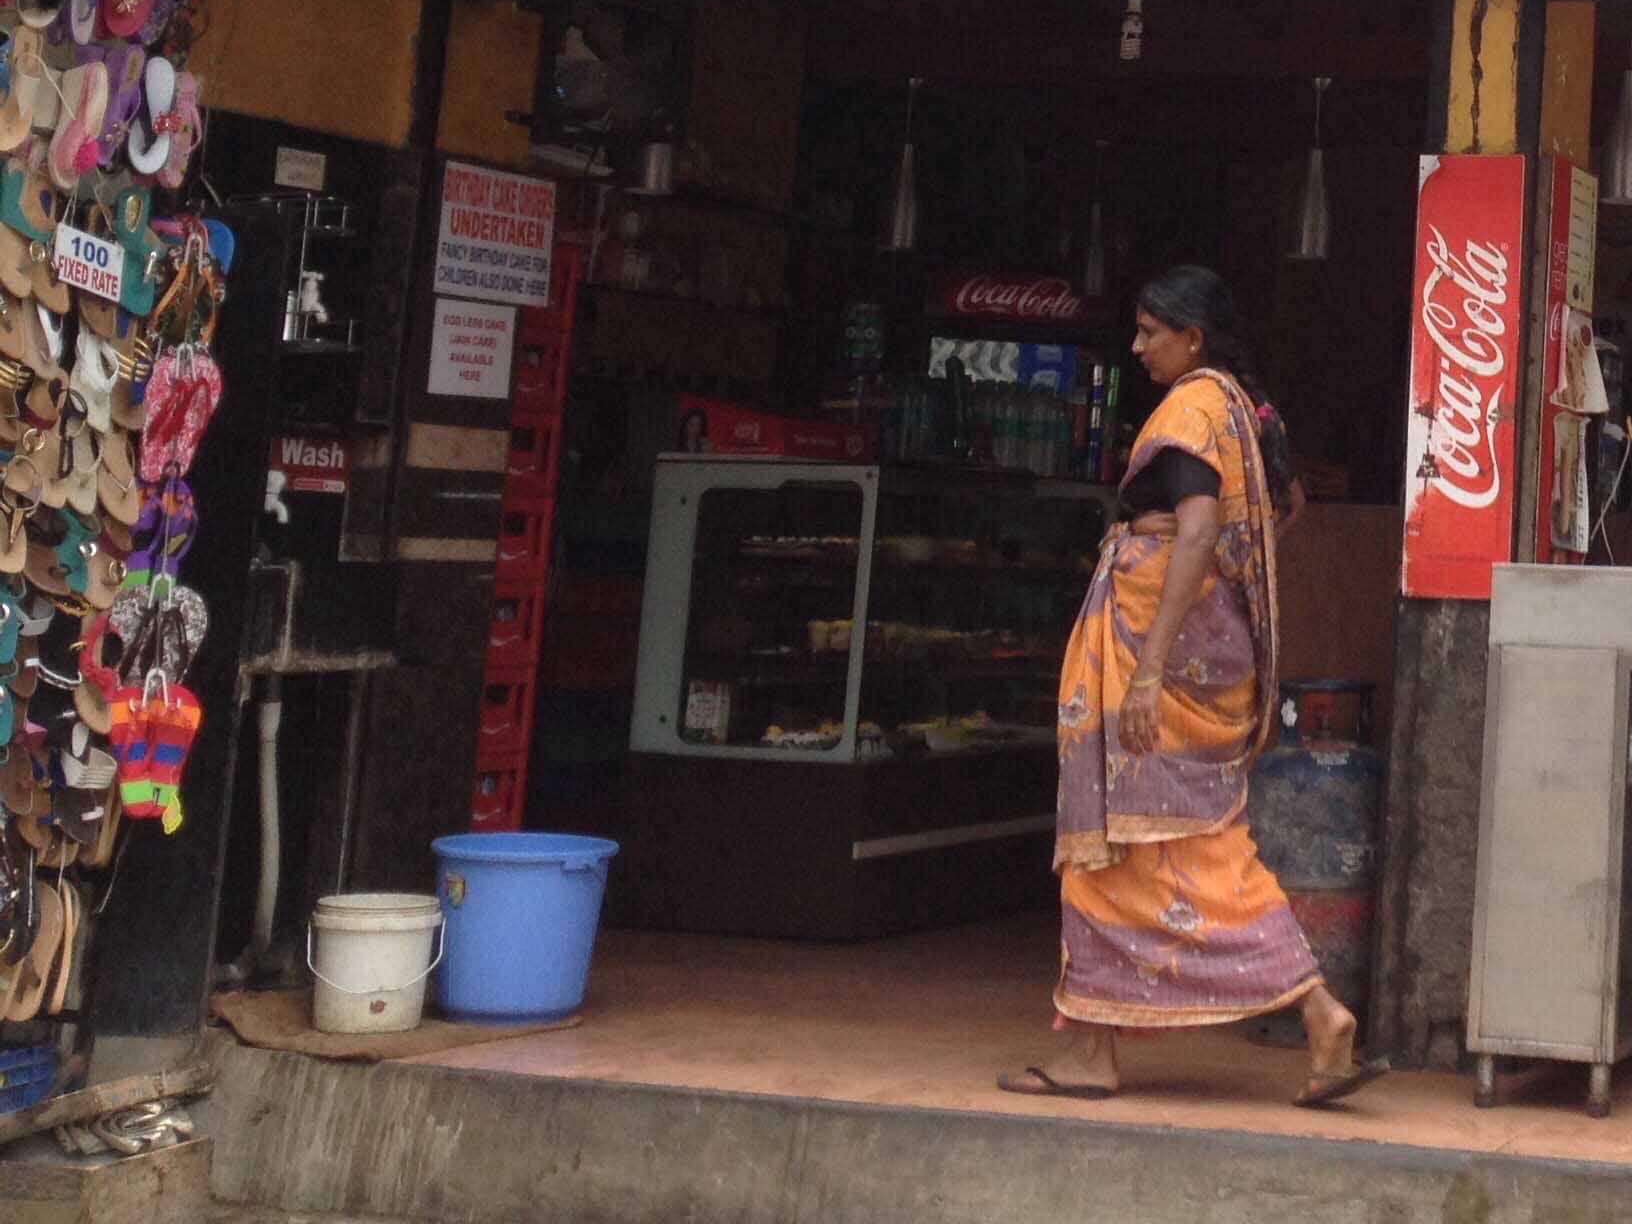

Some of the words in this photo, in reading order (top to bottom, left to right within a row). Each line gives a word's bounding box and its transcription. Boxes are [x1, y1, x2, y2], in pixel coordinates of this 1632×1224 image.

[450, 207, 545, 250] UNDERTAKEN
[71, 236, 108, 268] 100
[58, 255, 88, 285] FIXED
[92, 268, 119, 297] RATE
[1423, 222, 1509, 509] Coca-Cola
[281, 437, 345, 469] Wash
